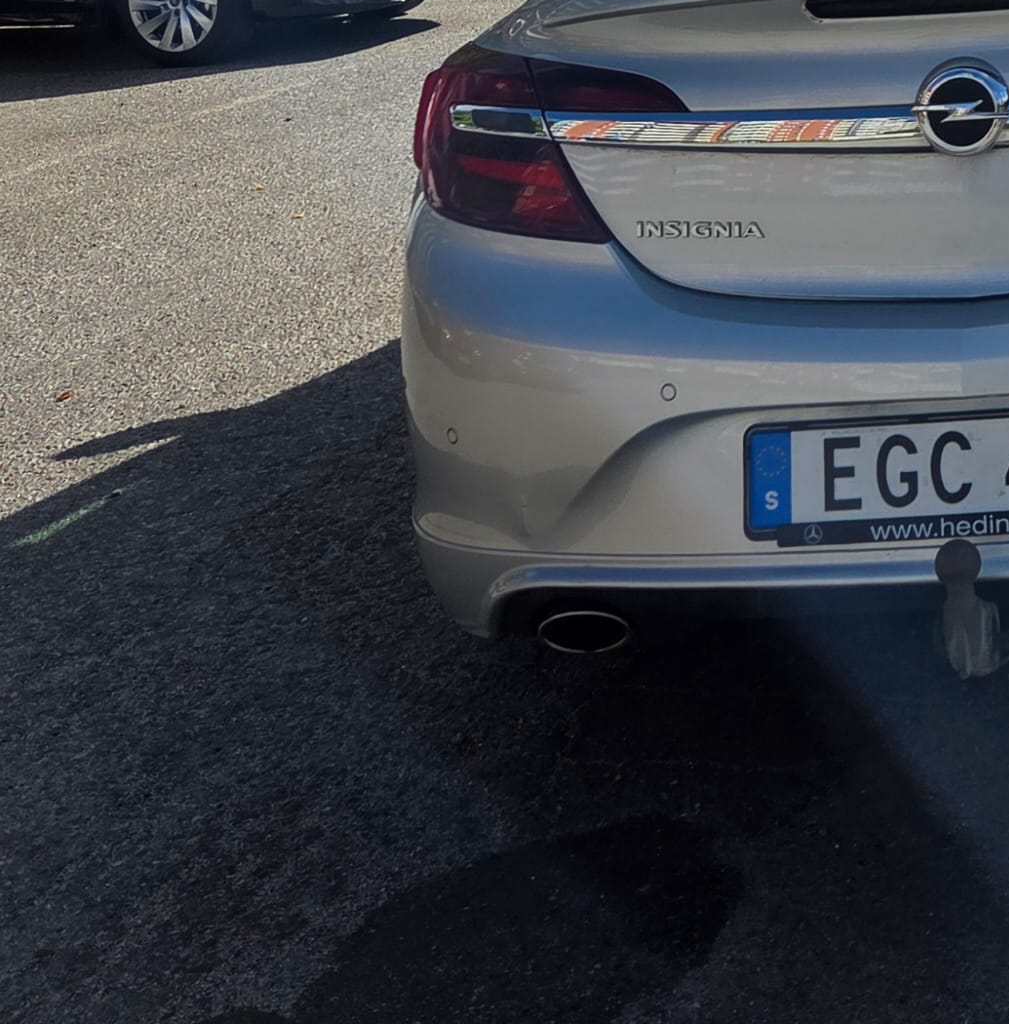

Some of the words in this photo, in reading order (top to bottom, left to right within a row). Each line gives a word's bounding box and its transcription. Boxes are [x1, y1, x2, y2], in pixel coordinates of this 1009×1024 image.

[636, 220, 766, 238] INSIGNIA
[823, 430, 973, 512] EGC
[764, 490, 780, 510] S
